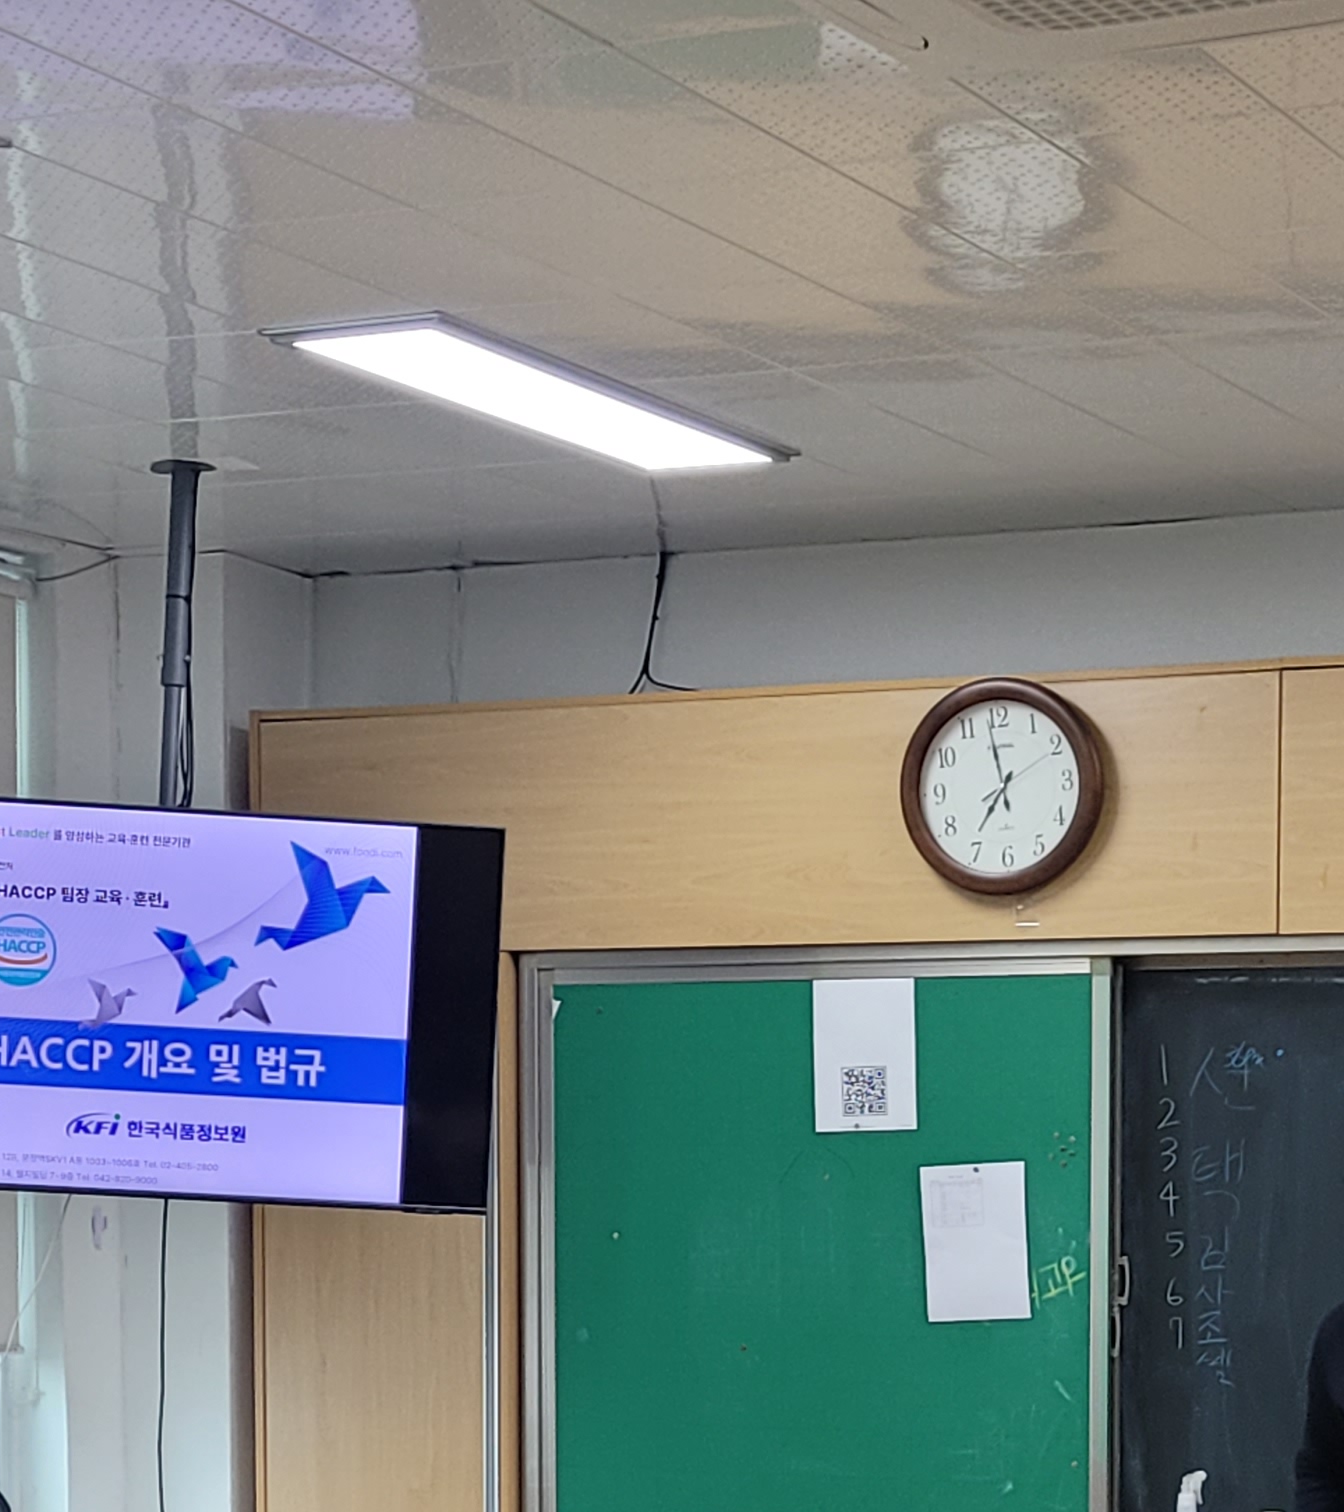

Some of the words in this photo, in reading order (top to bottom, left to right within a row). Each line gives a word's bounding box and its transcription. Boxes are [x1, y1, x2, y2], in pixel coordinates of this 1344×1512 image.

[960, 717, 975, 739] 11
[989, 706, 1010, 729] 12
[1029, 713, 1037, 734] 1
[1049, 734, 1063, 756] 2
[938, 747, 957, 769] 10
[1061, 769, 1074, 791] 3
[934, 783, 946, 805] 9
[944, 815, 957, 837] 8
[1053, 805, 1065, 826] 4
[9, 826, 50, 839] Leader
[971, 841, 983, 863] 7
[1001, 845, 1014, 868] 6
[1033, 834, 1045, 857] 5
[61, 887, 90, 904] 팀장
[123, 1039, 196, 1079] 개요
[207, 1042, 242, 1085] 및
[255, 1044, 327, 1088] 법규
[1160, 1043, 1168, 1086] 1
[1157, 1097, 1181, 1130] 2
[127, 1119, 246, 1144] 한국식품정보원
[1159, 1137, 1179, 1172] 3
[1159, 1180, 1181, 1217] 4
[1165, 1231, 1184, 1258] 5
[1167, 1276, 1184, 1306] 6
[1169, 1316, 1183, 1350] 7
